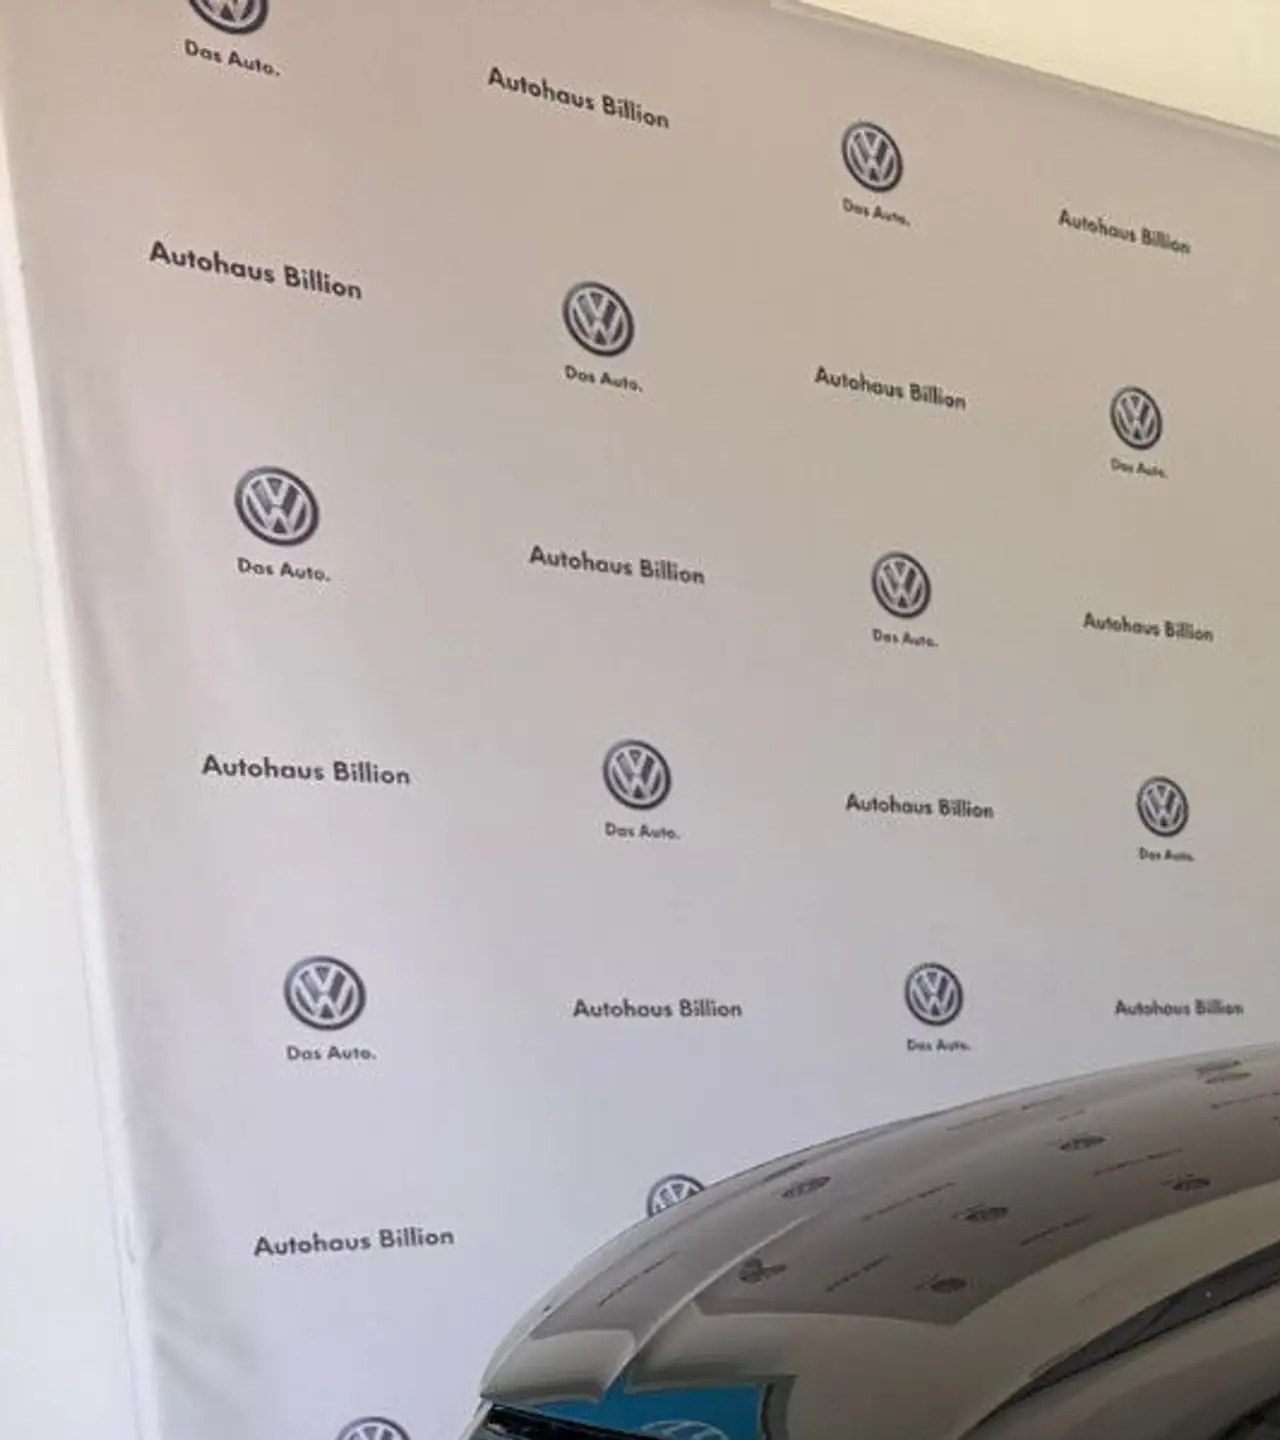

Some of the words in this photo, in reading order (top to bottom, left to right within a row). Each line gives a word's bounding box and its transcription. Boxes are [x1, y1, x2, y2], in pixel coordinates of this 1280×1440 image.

[185, 38, 222, 63] Das
[488, 67, 594, 110] Autohaus
[602, 95, 669, 128] Billion
[1058, 209, 1136, 243] Autohaus
[1141, 228, 1190, 254] Billion
[150, 241, 275, 284] Autohaus
[284, 265, 361, 300] Billion
[814, 366, 904, 399] Autohaus
[910, 383, 966, 409] Billion
[238, 557, 274, 575] Das
[529, 545, 632, 576] Autohaus
[640, 559, 704, 584] Billion
[1083, 612, 1160, 636] Autohaus
[1164, 620, 1213, 642] Billion
[202, 754, 324, 780] Autohaus
[333, 761, 410, 784] Billion
[846, 793, 933, 815] Autohaus
[938, 798, 994, 818] Billion
[573, 998, 673, 1017] Autohaus
[679, 998, 742, 1017] Billion
[1115, 1000, 1190, 1016] Autohaus
[1195, 999, 1244, 1015] Billion
[286, 1045, 322, 1060] Das
[254, 1232, 371, 1256] Autohaus
[379, 1227, 454, 1248] Billion
